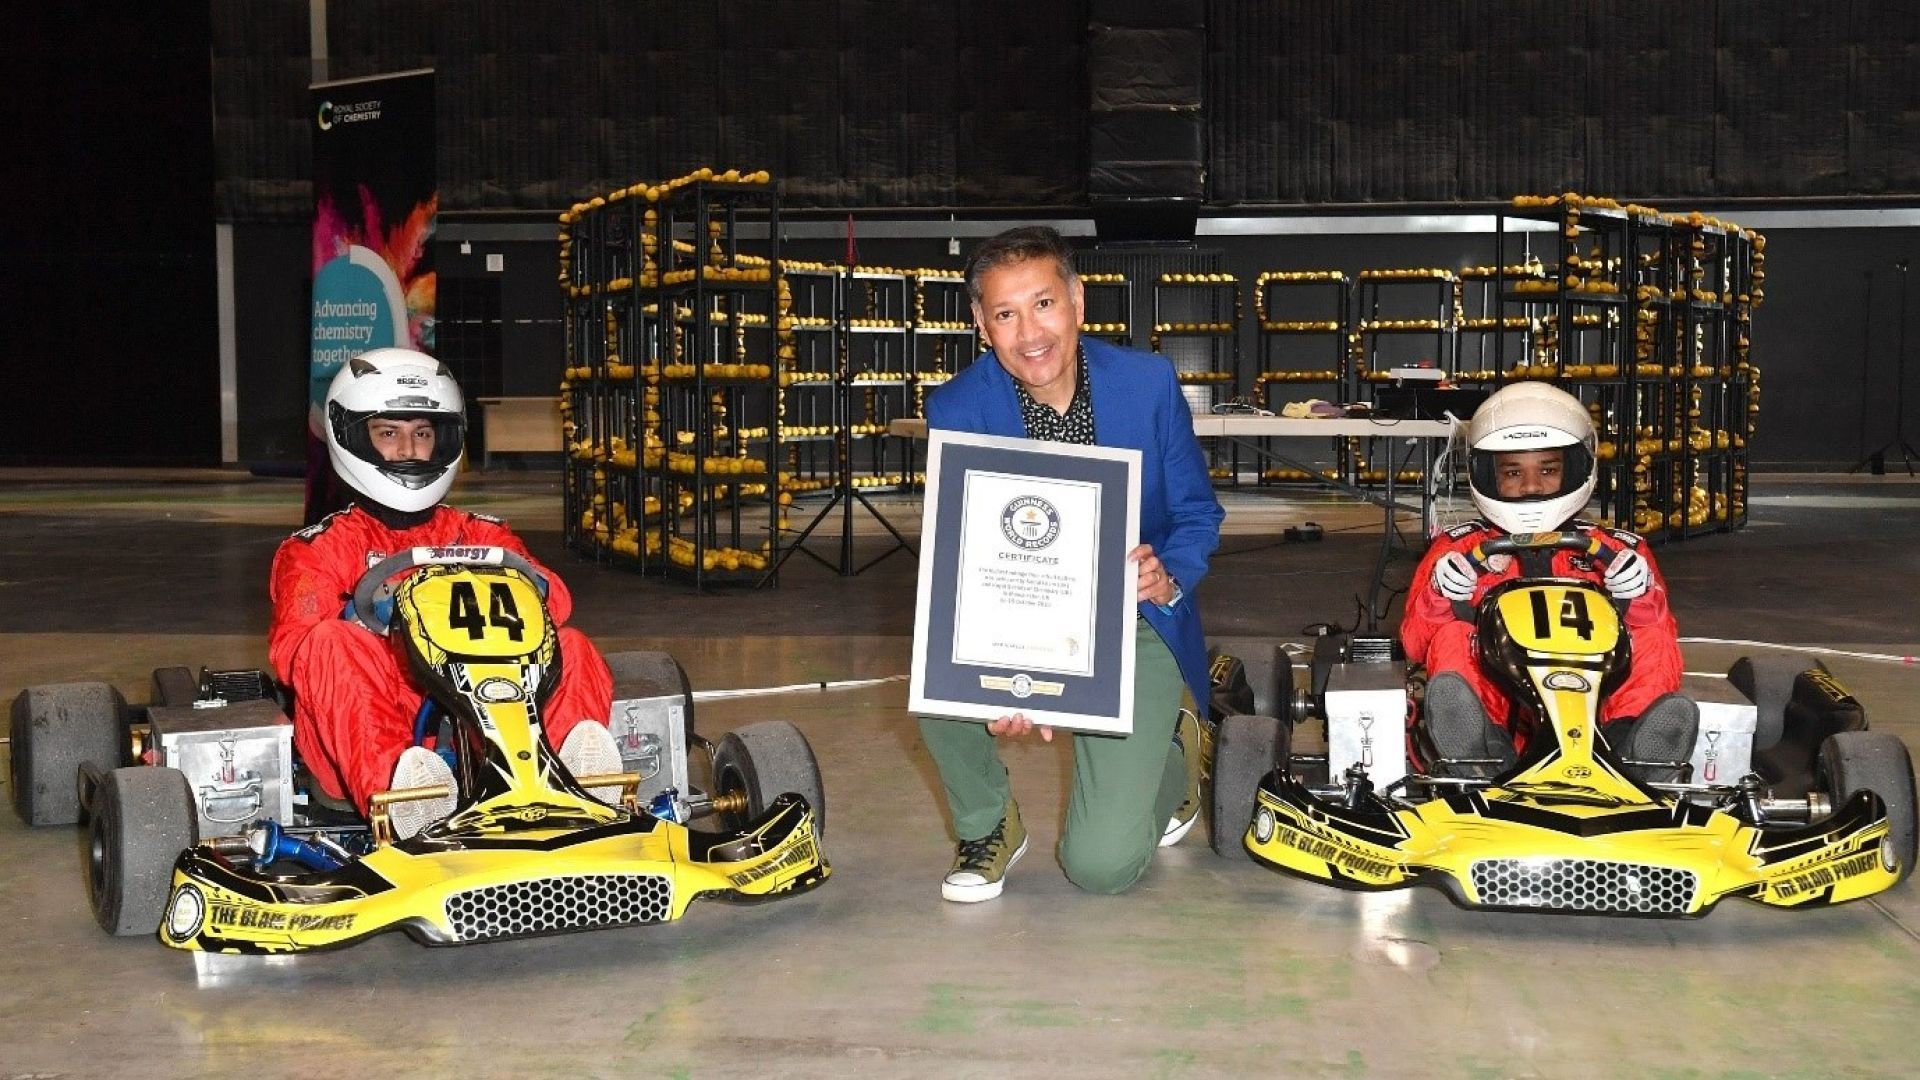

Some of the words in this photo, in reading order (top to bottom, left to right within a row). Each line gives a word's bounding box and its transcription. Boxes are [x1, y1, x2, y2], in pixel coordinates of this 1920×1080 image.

[355, 100, 381, 112] SOCIETY
[333, 114, 343, 124] OF
[344, 111, 381, 122] CHEMISTRY
[314, 299, 377, 320] Advancing
[314, 322, 374, 344] chemistry
[1010, 498, 1054, 515] GUINNESS
[1004, 517, 1024, 545] WORLD
[1026, 521, 1058, 548] RECORDS
[998, 552, 1059, 565] CERTIFICATE
[449, 581, 525, 642] 44
[1529, 590, 1594, 640] 14
[1276, 825, 1297, 848] THE
[1298, 836, 1338, 861] BLAIR
[1335, 850, 1396, 879] PROJECT
[1772, 879, 1799, 900] THE
[1793, 867, 1834, 893] BLAIR
[1831, 851, 1880, 882] PROJECT
[210, 905, 238, 926] THE
